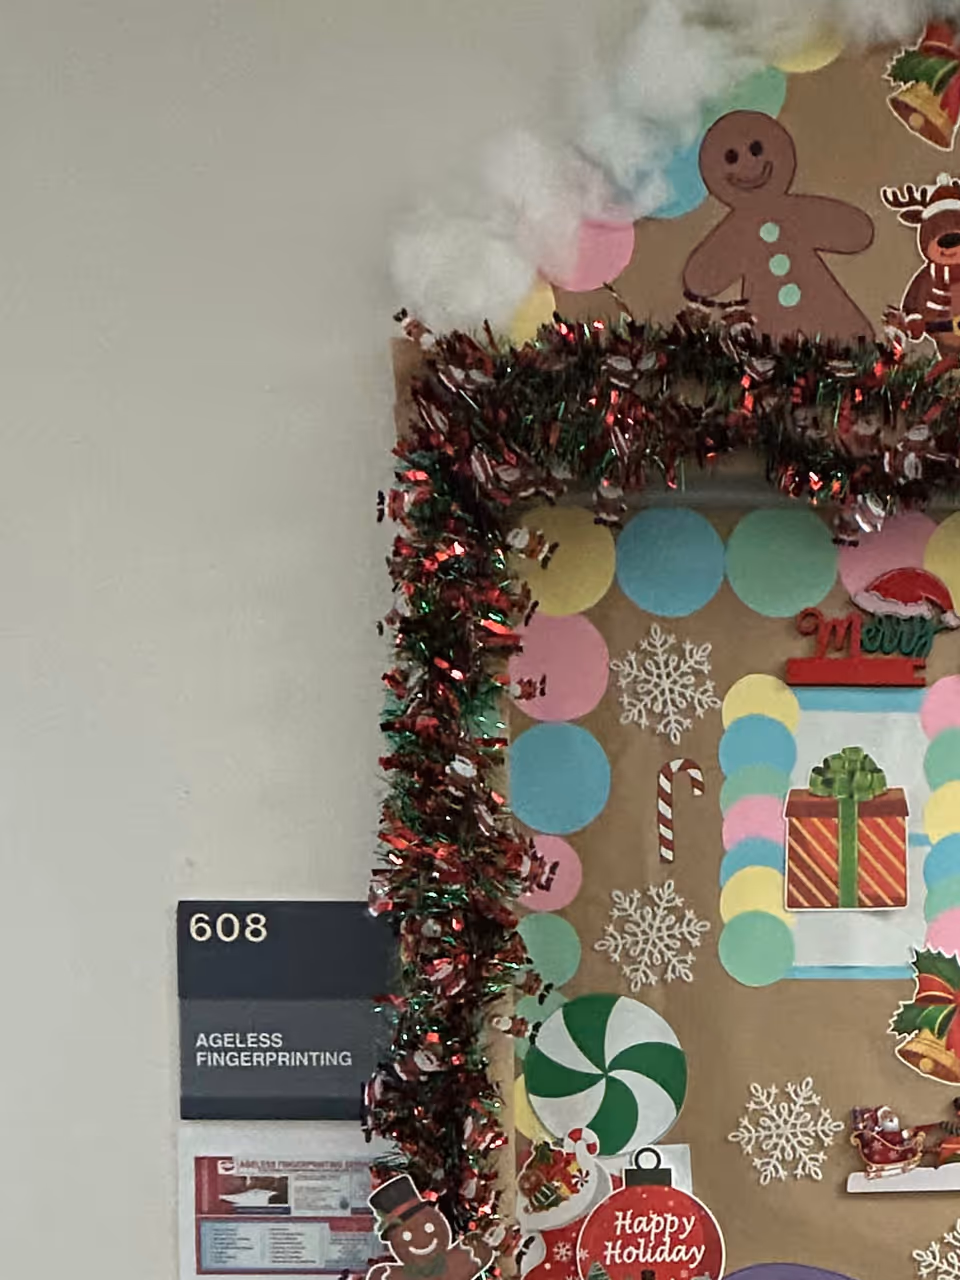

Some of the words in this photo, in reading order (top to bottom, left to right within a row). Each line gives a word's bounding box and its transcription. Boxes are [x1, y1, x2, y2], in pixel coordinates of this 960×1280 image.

[189, 912, 268, 942] 608
[195, 1032, 284, 1049] AGELESS
[195, 1050, 353, 1067] FINGERPRINTING
[613, 1209, 696, 1244] Happy
[603, 1237, 706, 1269] Holiday
